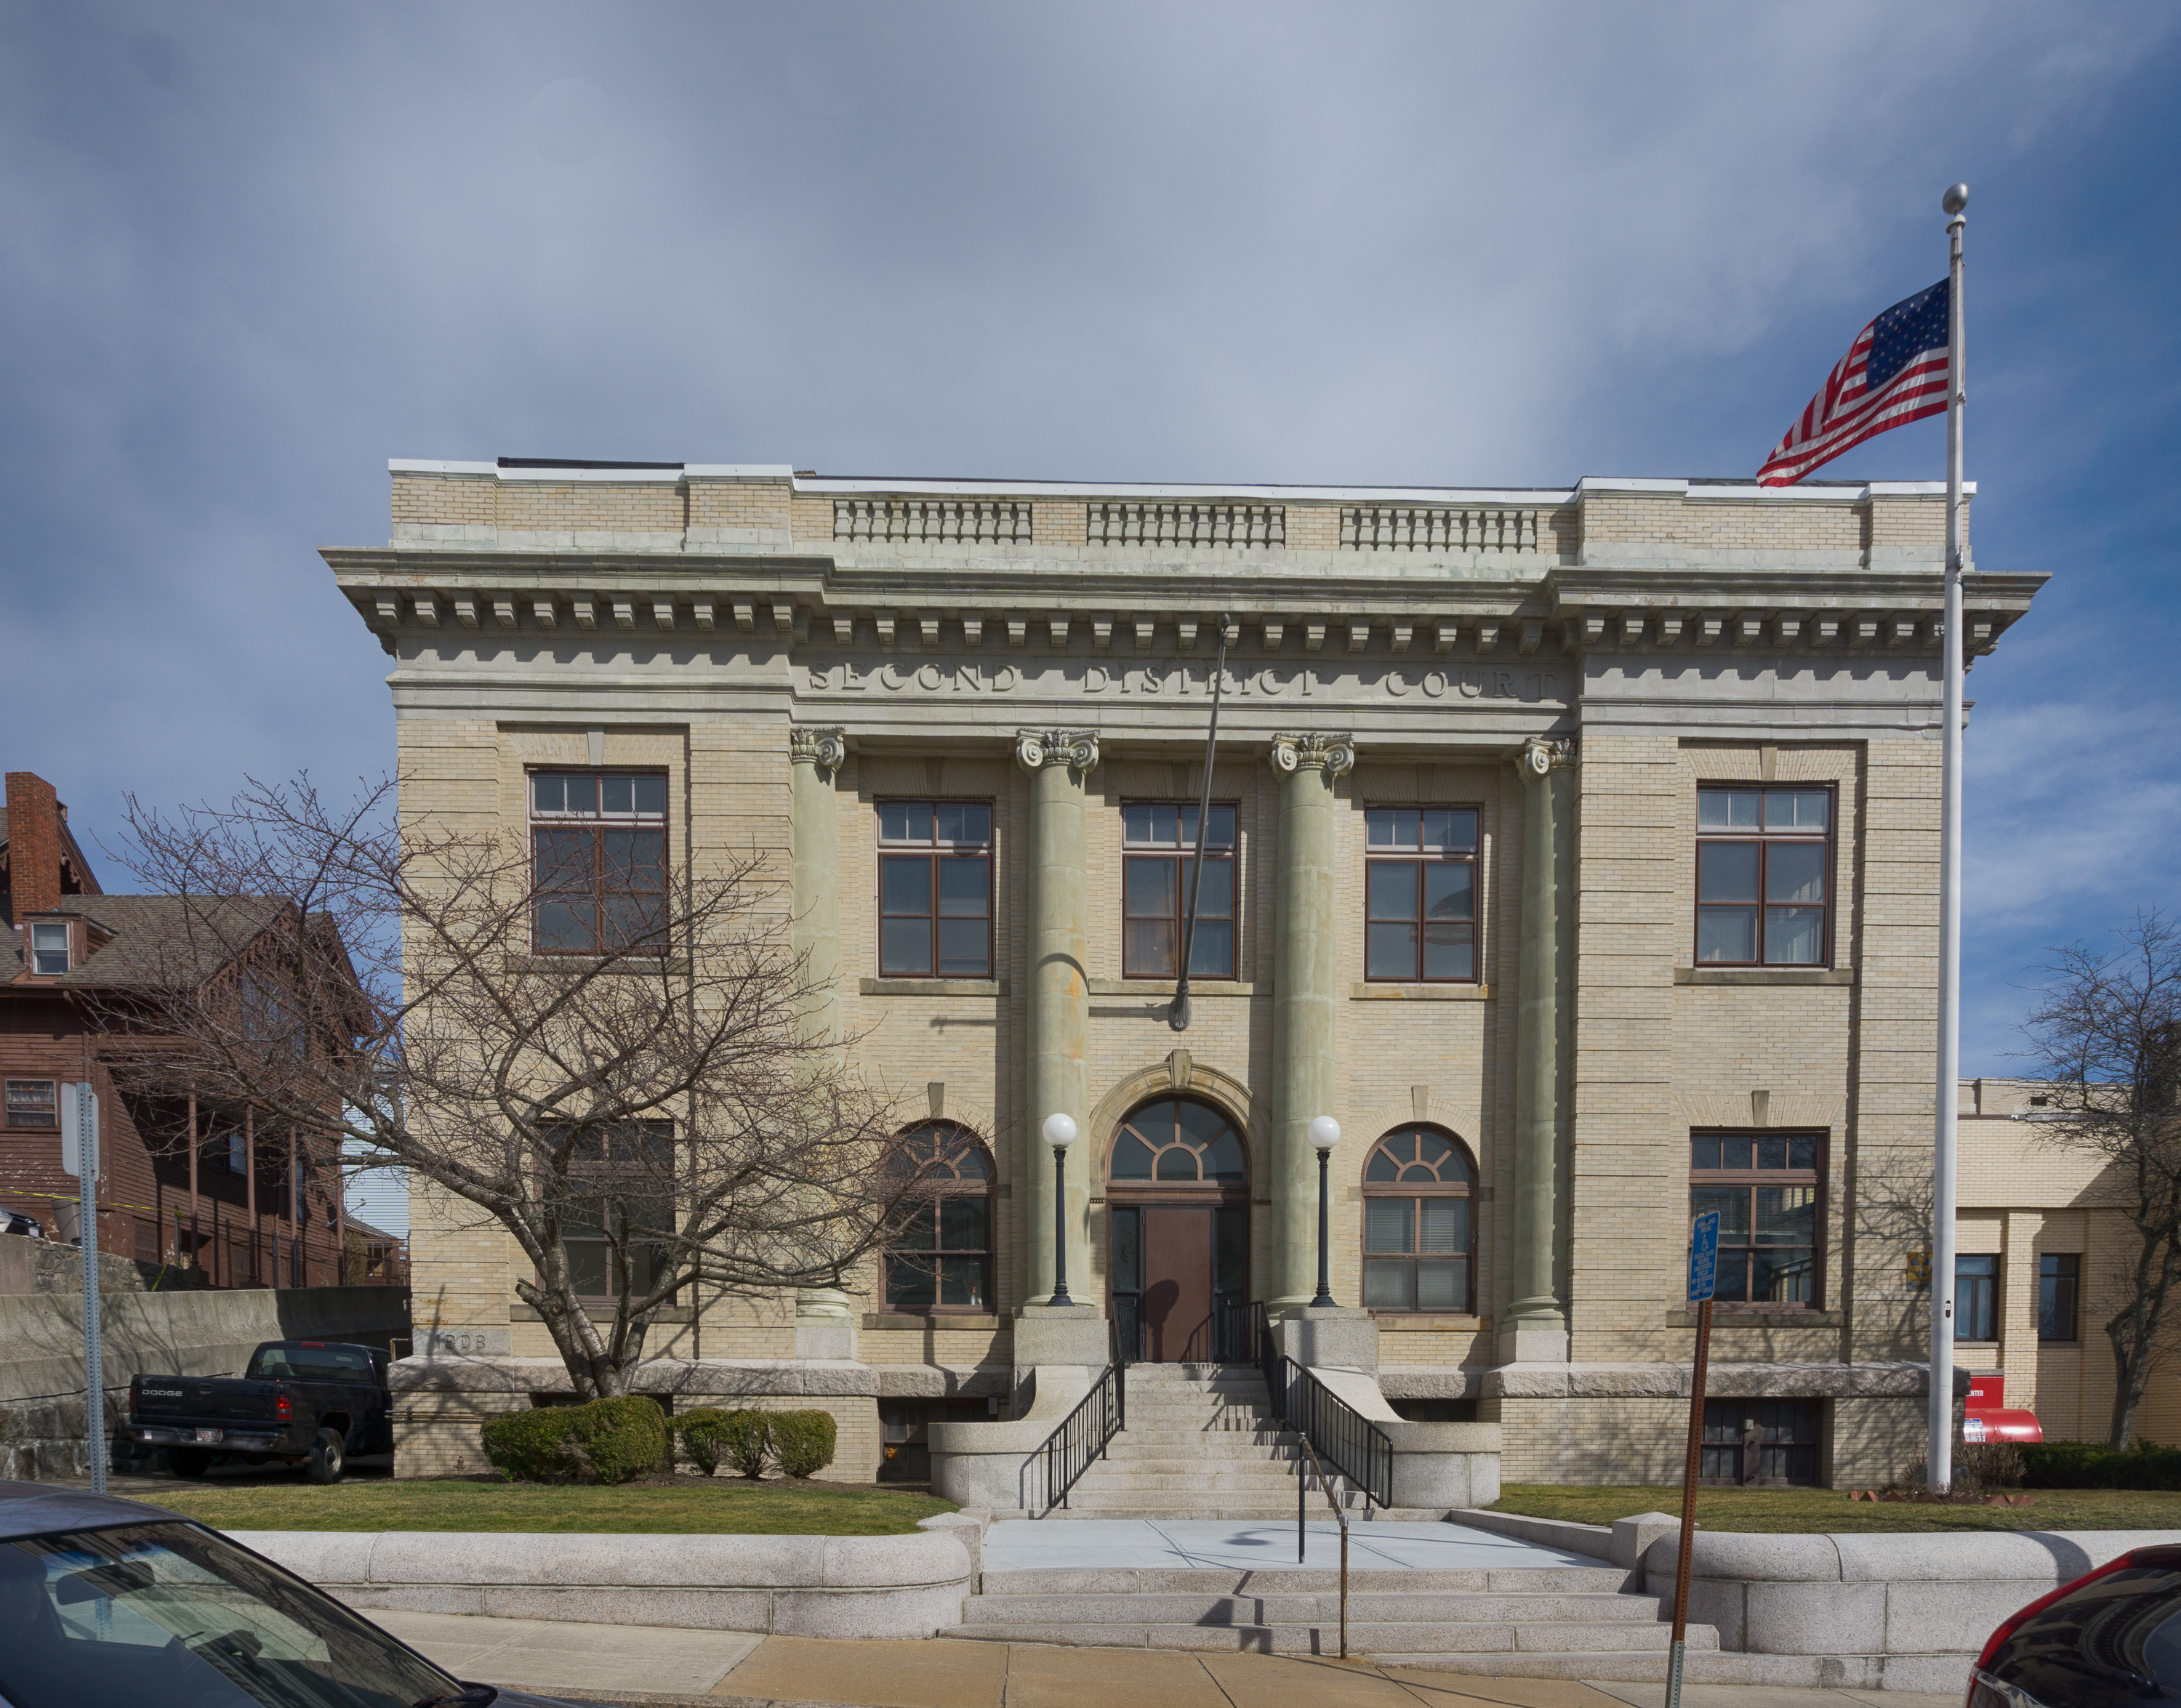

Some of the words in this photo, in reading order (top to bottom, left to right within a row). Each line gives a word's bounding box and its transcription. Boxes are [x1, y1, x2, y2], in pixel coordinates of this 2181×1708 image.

[809, 661, 1018, 692] SECOND
[1083, 664, 1322, 696] DISTRICT
[1385, 669, 1557, 699] COURT
[435, 1334, 486, 1350] 1908
